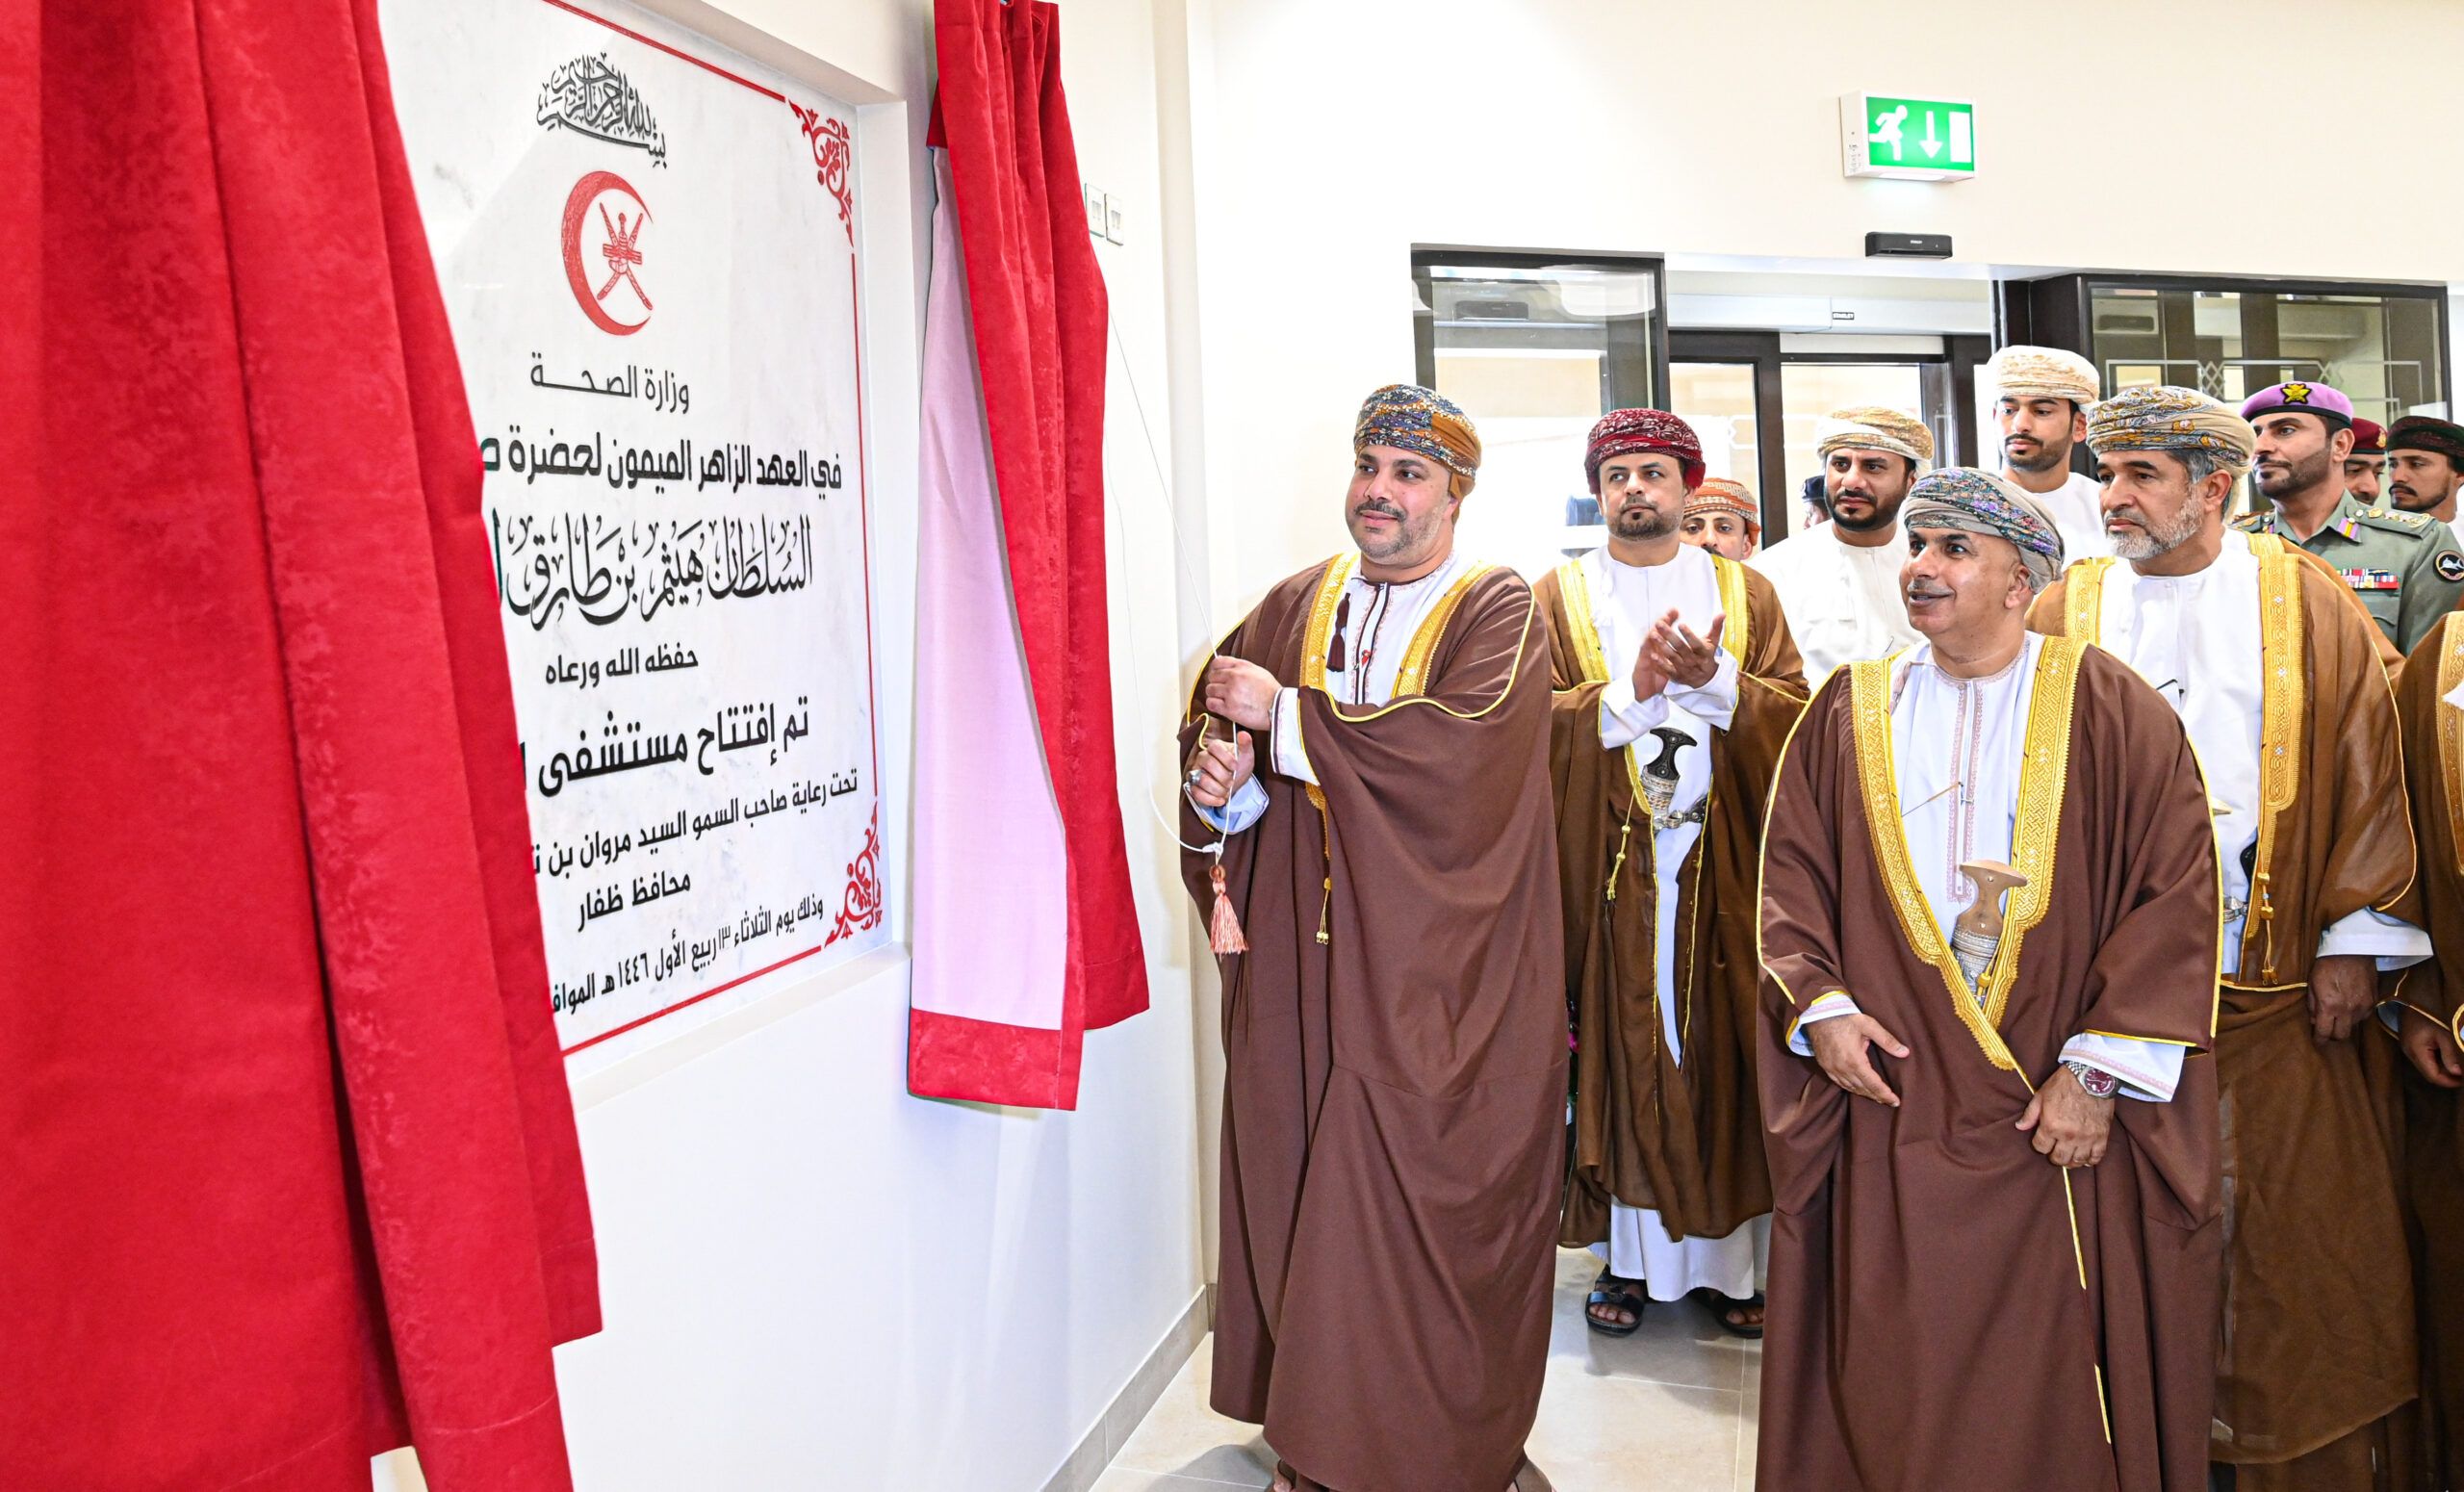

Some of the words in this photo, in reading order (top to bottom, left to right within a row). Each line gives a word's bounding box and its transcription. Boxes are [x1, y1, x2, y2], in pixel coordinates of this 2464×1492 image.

[645, 368, 690, 415] وزارة
[508, 424, 602, 485] لحضرة
[607, 439, 692, 494] الميمون
[698, 443, 752, 493] الزاهر
[757, 450, 808, 488] العهد
[810, 453, 842, 500] في
[545, 654, 600, 689] ورعاه
[605, 647, 640, 677] الله
[645, 642, 699, 673] حفظه
[696, 702, 777, 776] إفتتاح
[783, 695, 808, 752] تم
[538, 710, 688, 797] مستشفى
[791, 780, 827, 814] رعاية
[830, 767, 858, 797] تحت
[692, 797, 739, 840] السمو
[743, 788, 787, 829] صاحب
[579, 831, 631, 868] مروان
[637, 810, 686, 855] السيد
[549, 841, 573, 879] بن
[578, 883, 624, 933] ظفار
[631, 870, 691, 907] محافظ
[797, 893, 824, 919] وذلك
[734, 905, 772, 947] الثلاثاء
[776, 909, 795, 937] يوم
[618, 953, 650, 988] ١٤٤٦
[655, 929, 685, 981] الأول
[691, 937, 716, 972] ربيع
[553, 971, 595, 1016] المواف
